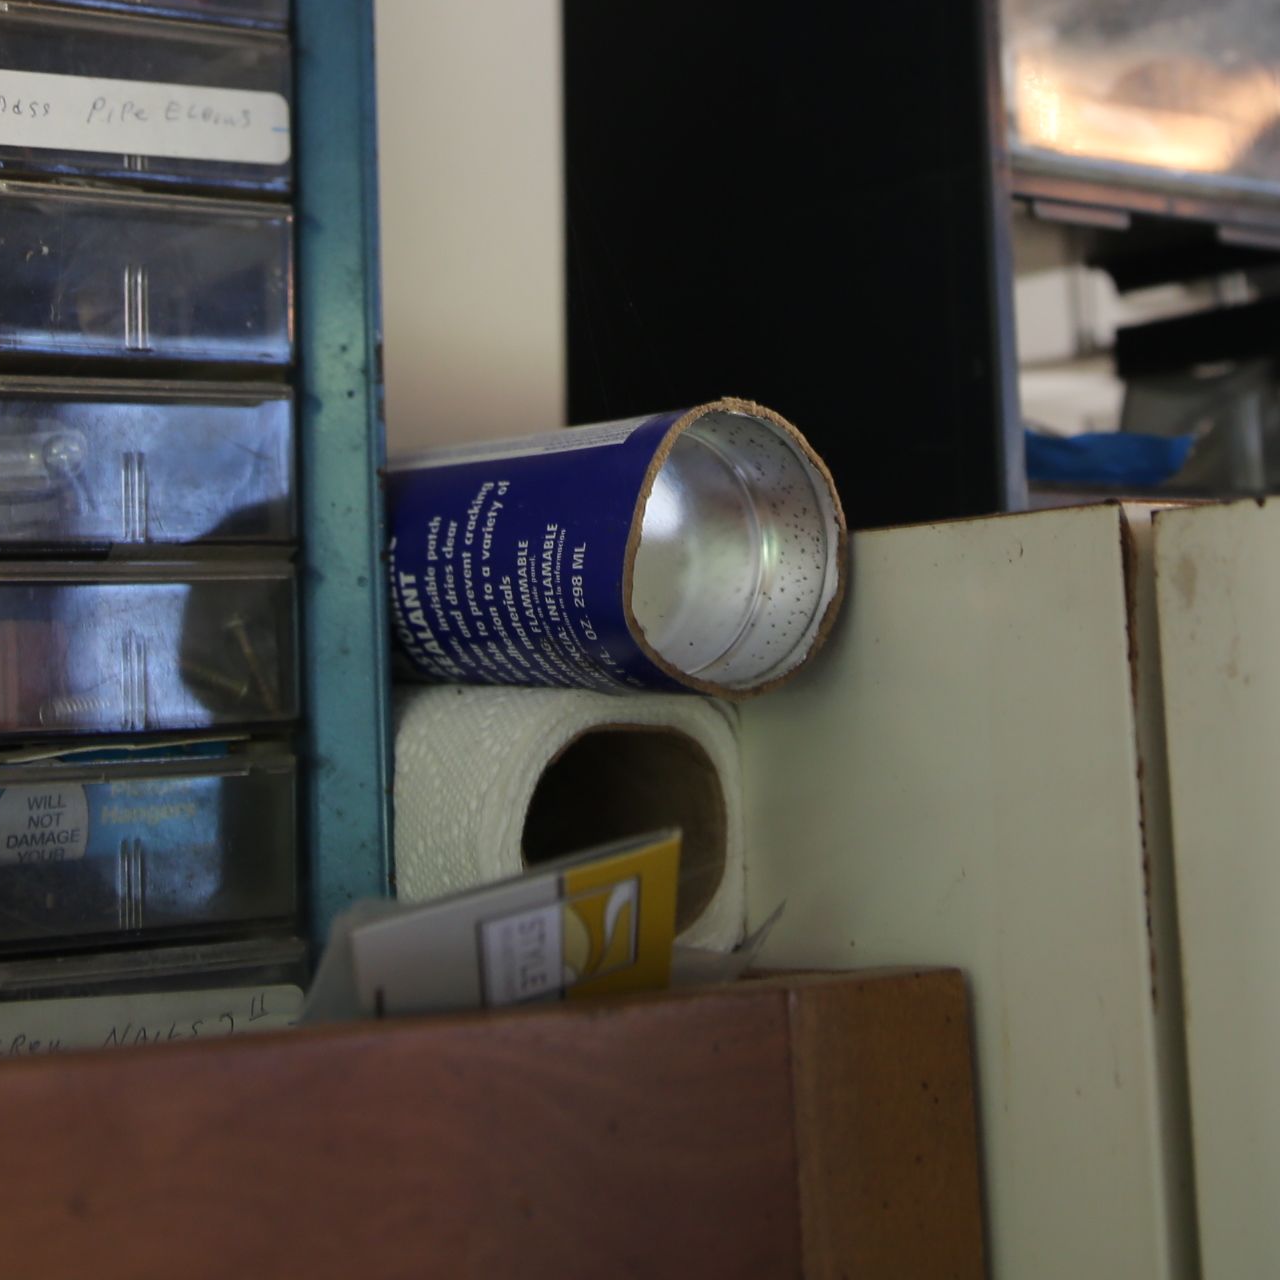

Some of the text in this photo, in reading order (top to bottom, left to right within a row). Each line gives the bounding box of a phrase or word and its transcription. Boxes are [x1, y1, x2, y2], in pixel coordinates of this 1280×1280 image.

[441, 520, 458, 559] clear
[461, 481, 495, 637] to prevent cracking
[571, 541, 587, 570] ML
[424, 516, 450, 632] invisible patch
[443, 564, 459, 606] dries
[481, 480, 531, 668] adhesion to a variety of
[517, 539, 542, 633] FLAMMABLE
[529, 553, 538, 584] panel.
[541, 523, 561, 622] INFLAMABLE
[571, 574, 585, 609] 298
[399, 570, 466, 676] SEALANT
[449, 610, 472, 639] and
[499, 575, 535, 650] materials
[579, 613, 598, 641] OZ.
[26, 794, 68, 811] WILL
[27, 812, 63, 829] NOT
[5, 829, 82, 850] DAMAGE
